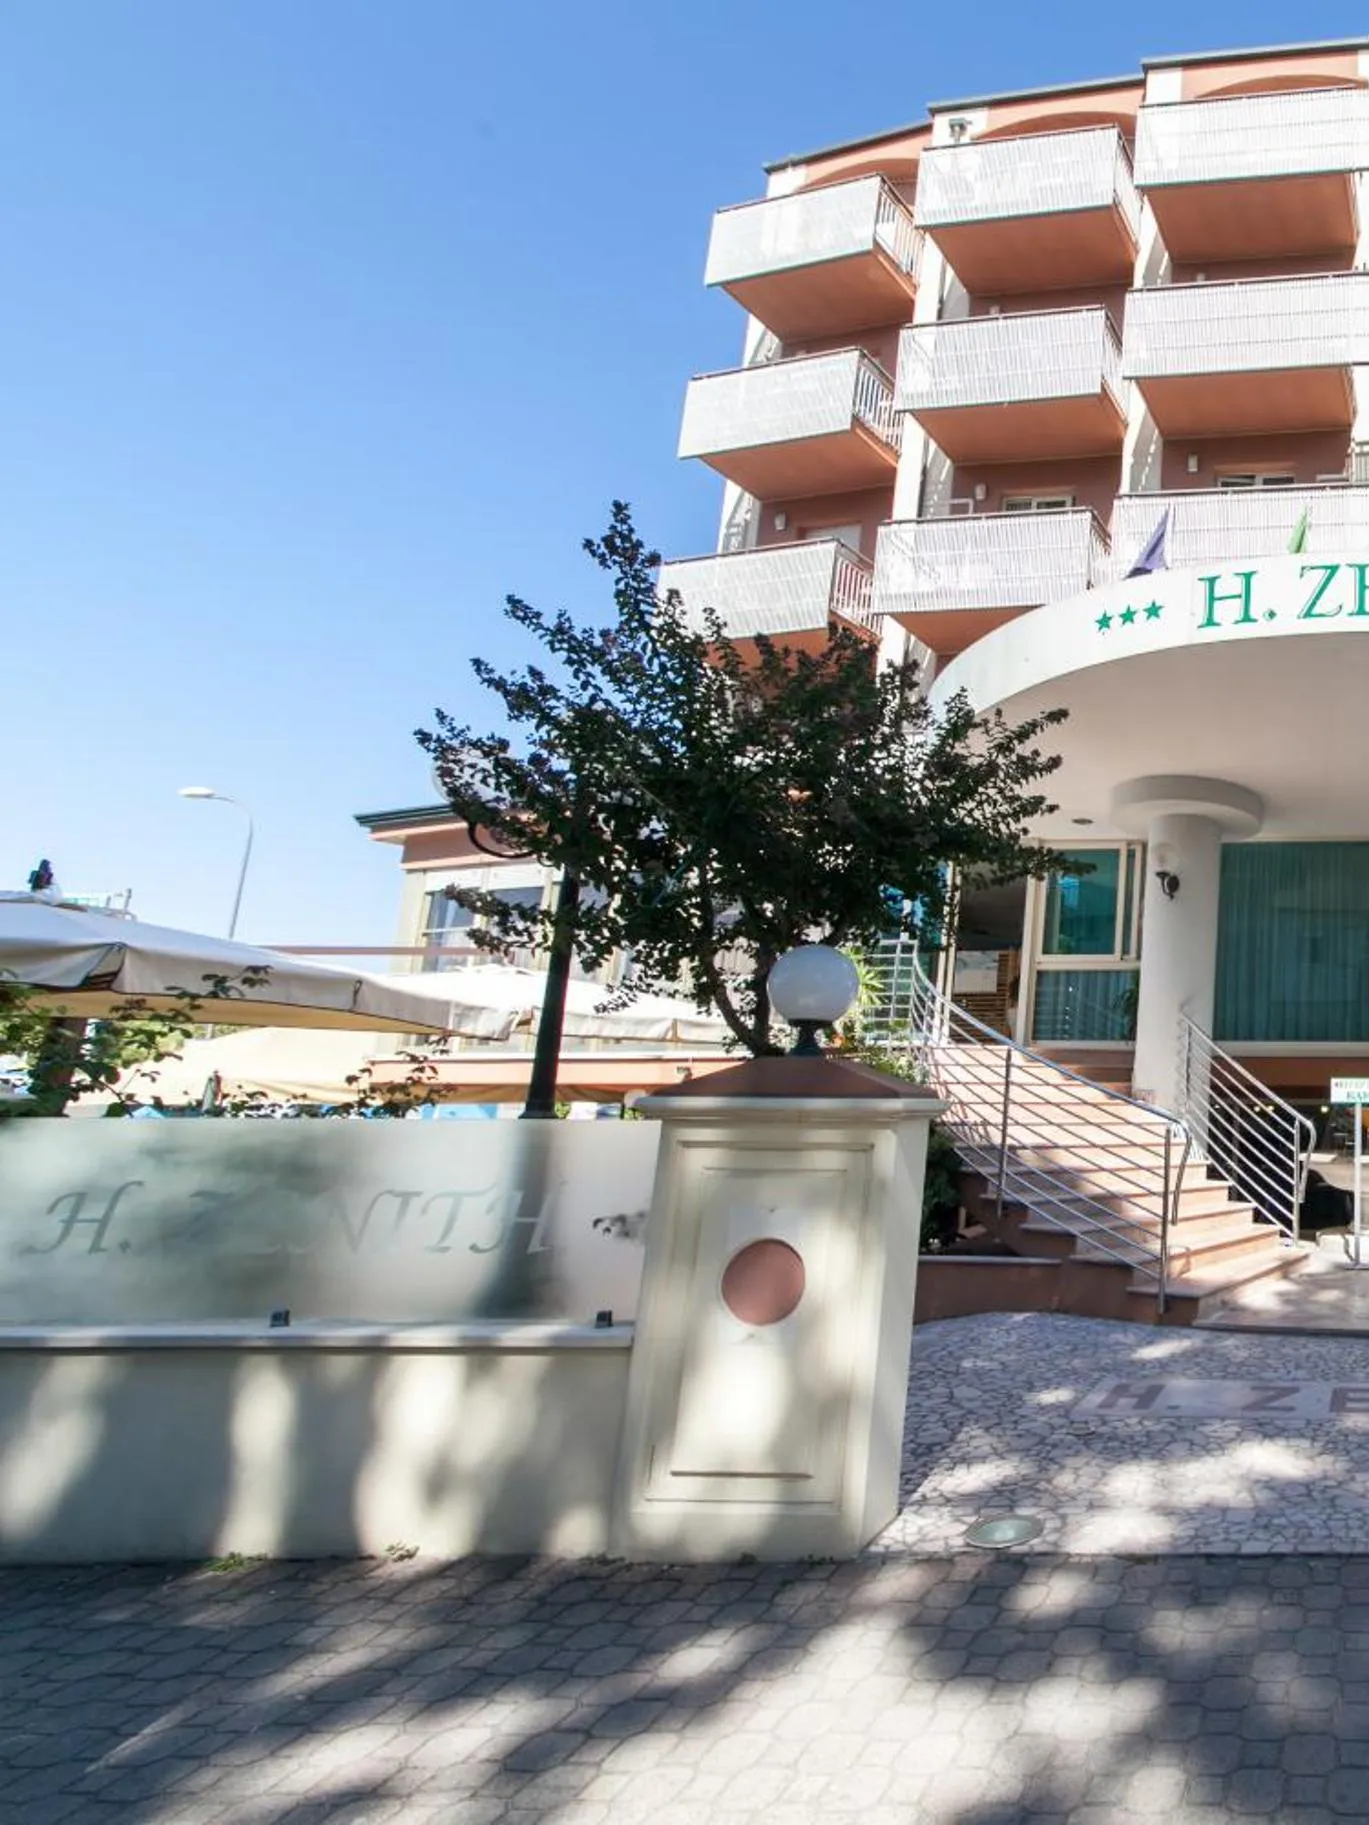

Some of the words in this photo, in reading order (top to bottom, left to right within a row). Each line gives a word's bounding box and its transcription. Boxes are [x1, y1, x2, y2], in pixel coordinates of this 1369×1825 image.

[1197, 570, 1278, 629] H.
[12, 1179, 146, 1256] H.
[1096, 1384, 1180, 1410] H.
